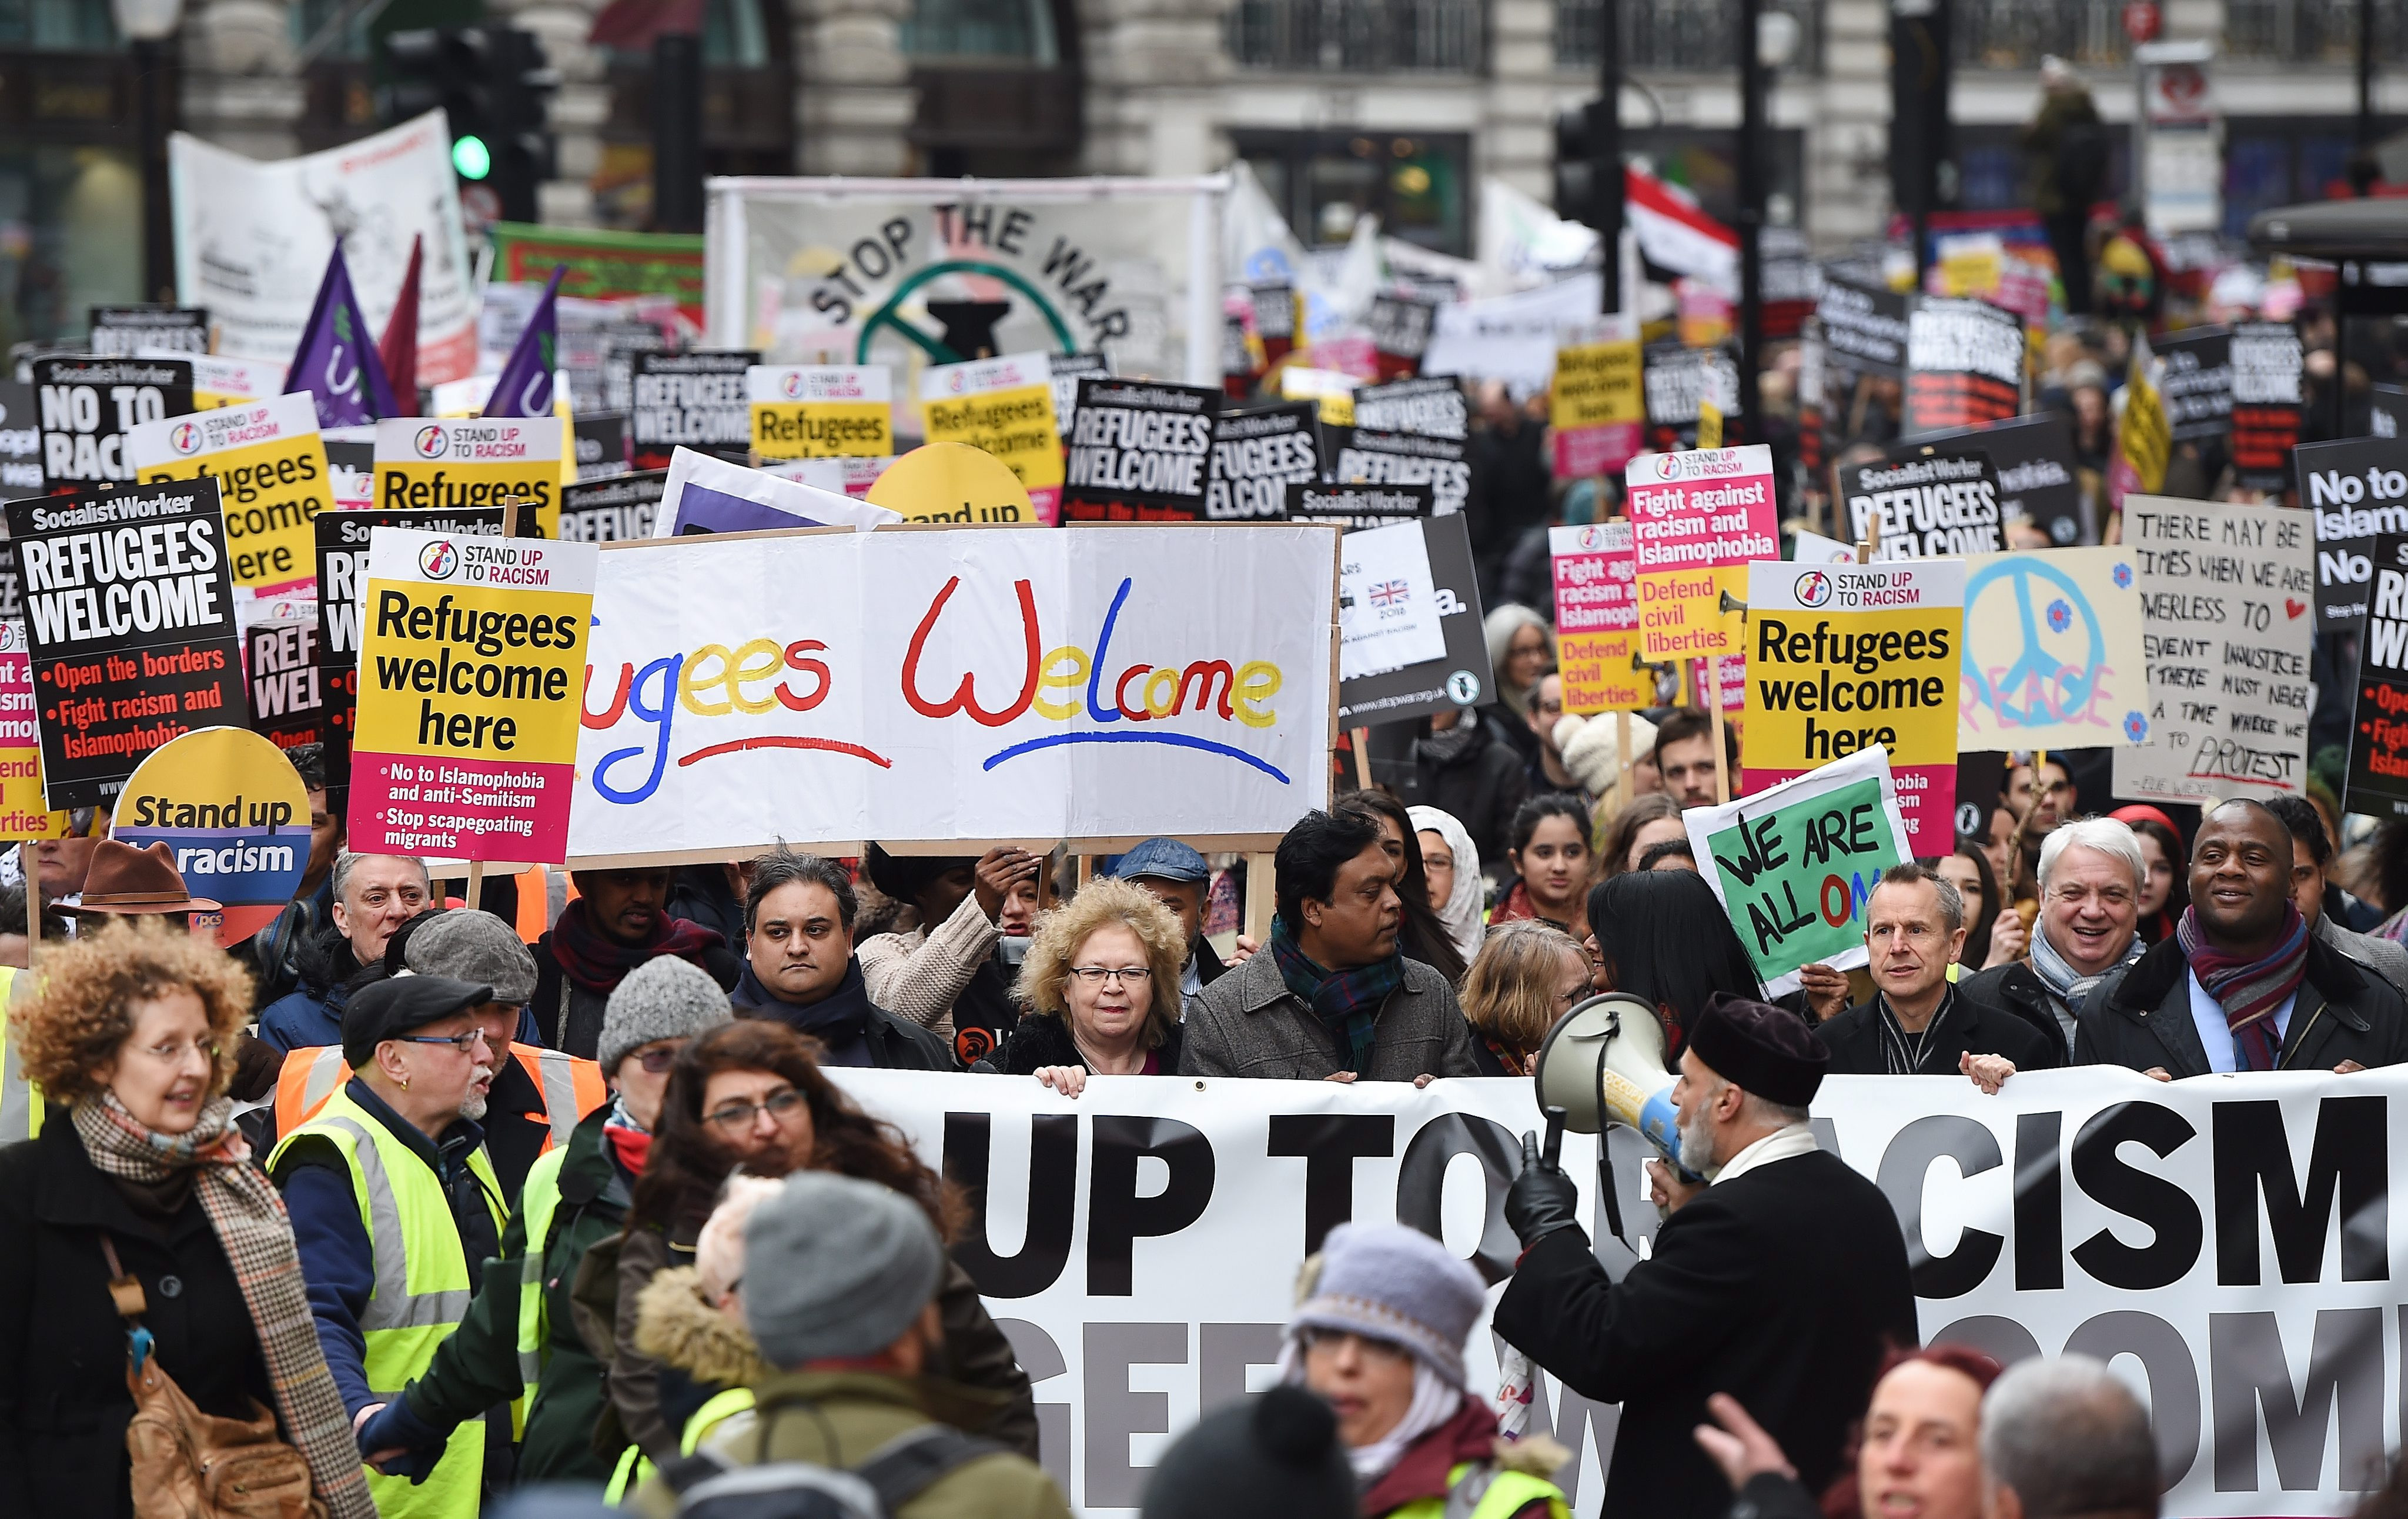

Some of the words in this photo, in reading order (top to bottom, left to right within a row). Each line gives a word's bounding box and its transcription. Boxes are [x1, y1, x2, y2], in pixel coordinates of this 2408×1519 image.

[809, 215, 913, 325] STOP
[934, 201, 1035, 255] THE
[1039, 235, 1131, 353] WAR
[40, 385, 101, 433] NO
[110, 385, 166, 433] TO
[206, 415, 248, 431] STAND
[249, 408, 269, 423] UP
[209, 433, 226, 447] TO
[229, 422, 280, 445] RACISM
[454, 428, 497, 443] STAND
[500, 428, 520, 442] UP
[760, 410, 883, 447] Refugees
[1072, 406, 1212, 455] REFUGEES
[44, 433, 138, 482] RACI
[454, 443, 471, 457] TO
[475, 443, 526, 458] RACISM
[1209, 430, 1317, 480] FUGEES
[1685, 452, 1718, 464] STAND
[1721, 450, 1736, 462] UP
[1687, 465, 1701, 476] TO
[1703, 462, 1744, 475] RACISM
[1067, 445, 1206, 496] WELCOME
[2309, 469, 2366, 507] No
[2366, 465, 2407, 499] to
[385, 471, 550, 509] Refugees
[1633, 489, 1686, 518] Fight
[1690, 480, 1765, 513] against
[32, 492, 195, 530] SocialistWorker
[226, 496, 322, 539] come
[1636, 516, 1707, 540] racism
[1710, 508, 1749, 533] and
[1848, 479, 1999, 540] REFUGEES
[2313, 504, 2408, 542] Islam
[1637, 532, 1775, 566] Islamophobia
[2137, 512, 2211, 541] THERE
[2222, 516, 2267, 547] MAY
[2277, 518, 2303, 549] BE
[21, 519, 218, 593] REFUGEES
[230, 546, 293, 581] ere
[464, 545, 517, 565] STAND
[521, 550, 543, 567] UP
[1558, 557, 1605, 585] Fight
[2136, 550, 2191, 577] TIMES
[2200, 556, 2243, 587] WHEN
[2252, 559, 2276, 586] WE
[2279, 566, 2313, 593] ARE
[2319, 548, 2373, 587] No
[464, 564, 484, 581] TO
[489, 567, 550, 586] RACISM
[1559, 581, 1622, 605] racism
[1642, 575, 1715, 602] Defend
[1838, 573, 1887, 589] STAND
[1891, 572, 1912, 587] UP
[27, 572, 223, 646] WELCOME
[1645, 603, 1685, 627] civil
[1838, 592, 1858, 606] TO
[1862, 589, 1920, 606] RACISM
[2142, 591, 2227, 625] WERLESS
[2243, 600, 2271, 633] TO
[377, 589, 578, 657] Refugees
[1647, 627, 1728, 653] liberties
[1564, 638, 1628, 661] Defend
[1758, 619, 1950, 674] Refugees
[2144, 634, 2212, 659] EVENT
[54, 662, 102, 693] Open
[106, 655, 141, 683] the
[143, 646, 226, 677] borders
[376, 647, 568, 701] welcome
[1566, 664, 1601, 684] civil
[2157, 665, 2210, 690] THERE
[2221, 674, 2262, 696] MUST
[59, 698, 108, 733] Fight
[112, 689, 176, 718] racism
[185, 681, 222, 710] and
[580, 637, 831, 804] ugees
[901, 575, 1283, 728] Welcome
[1567, 685, 1640, 707] liberties
[1760, 670, 1944, 712] welcome
[418, 698, 517, 751] here
[2152, 700, 2166, 719] A
[2180, 701, 2219, 726] TIME
[2231, 712, 2278, 736] WHERE
[1805, 717, 1897, 759] here
[2167, 731, 2190, 750] TO
[2191, 736, 2300, 779] PROTEST
[390, 763, 413, 782] No
[418, 769, 434, 783] to
[439, 769, 546, 790] Islamophobia
[389, 784, 419, 802] and
[423, 788, 536, 809] anti-Semitism
[133, 795, 243, 828] Stand
[248, 802, 293, 836] up
[386, 807, 424, 830] Stop
[428, 813, 534, 837] scapegoating
[177, 839, 294, 875] racism
[384, 829, 457, 850] migrants
[1715, 812, 1790, 887] WE
[1803, 803, 1879, 869] ARE
[199, 914, 223, 927] pcs
[1747, 880, 1817, 956] ALL
[1821, 869, 1881, 928] ON
[942, 1111, 1216, 1298] UP
[1267, 1111, 1529, 1288] TO
